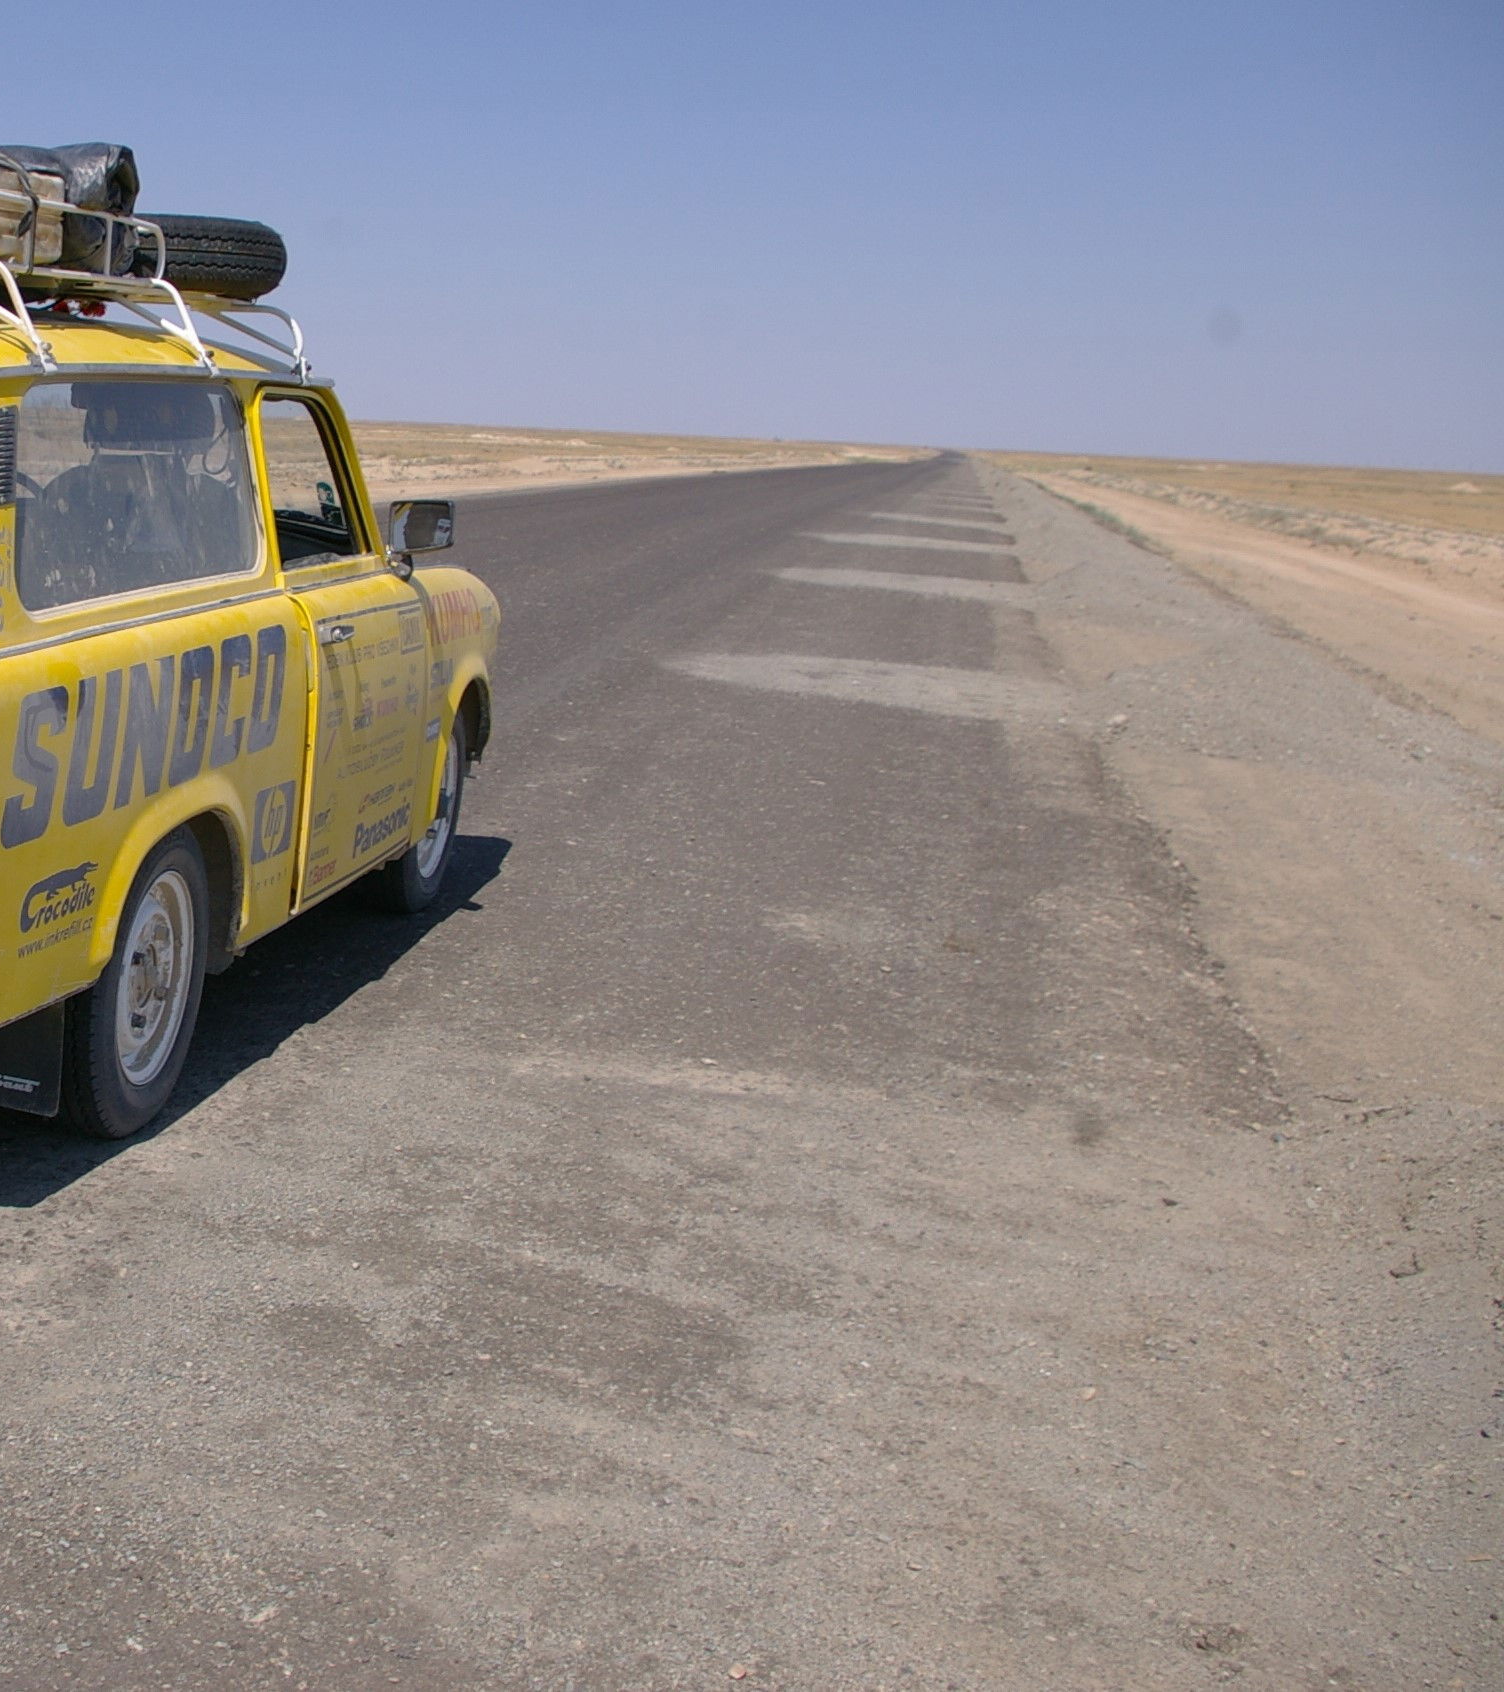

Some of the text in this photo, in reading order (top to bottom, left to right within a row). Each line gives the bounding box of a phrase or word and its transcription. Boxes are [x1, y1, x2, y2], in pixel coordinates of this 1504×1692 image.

[0, 624, 288, 850] SUNOCO
[353, 799, 411, 859] Panasonic
[20, 882, 96, 934] Crocodile
